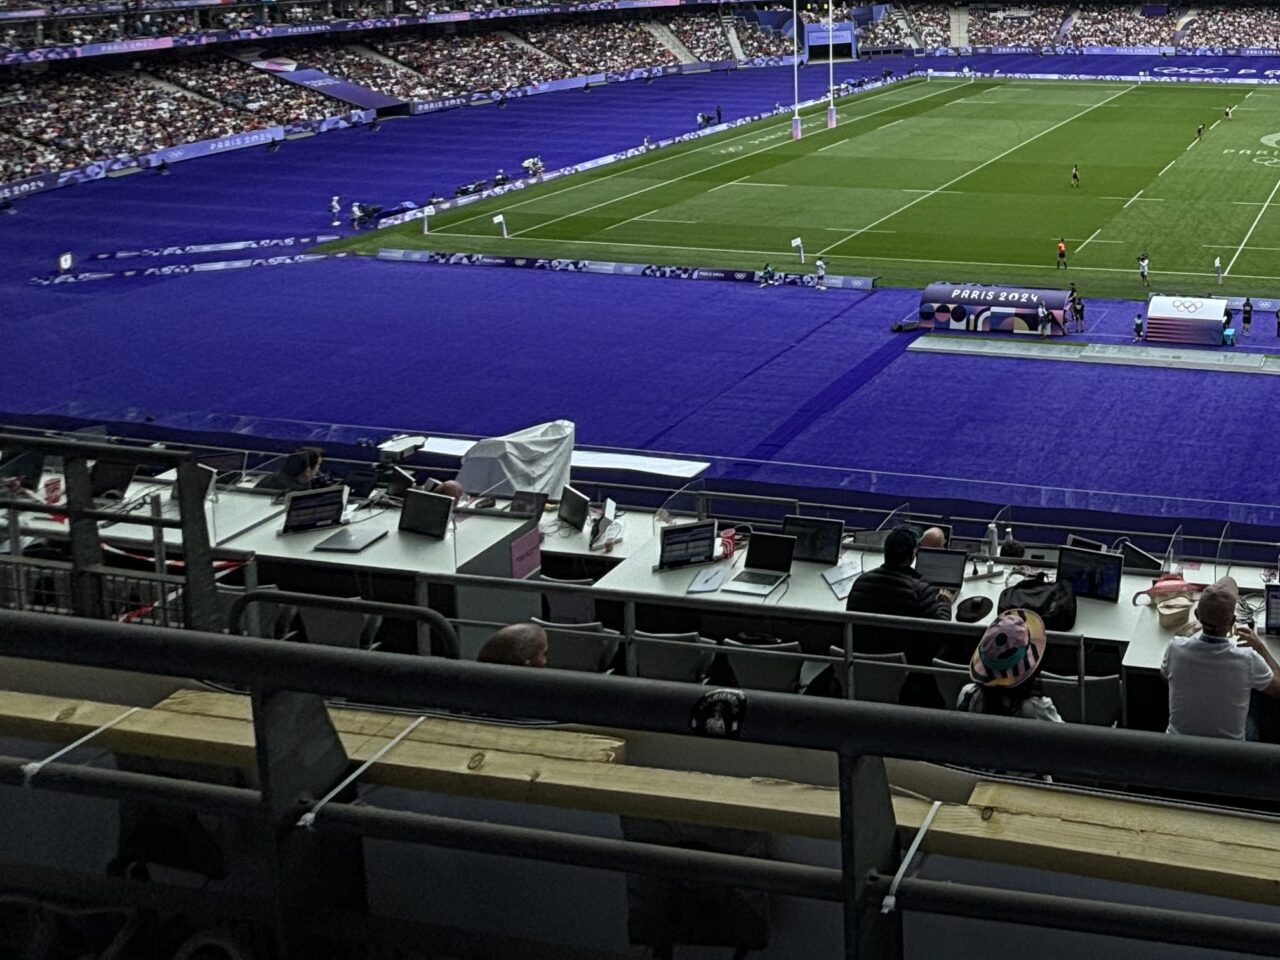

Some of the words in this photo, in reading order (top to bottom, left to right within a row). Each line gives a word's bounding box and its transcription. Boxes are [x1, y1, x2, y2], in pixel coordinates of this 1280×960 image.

[418, 102, 442, 111] PARIS
[444, 98, 466, 107] 2024
[210, 139, 241, 150] PARIS
[245, 133, 272, 144] 2024
[14, 182, 44, 195] 2024
[952, 289, 995, 300] PARIS
[999, 292, 1038, 303] 2024
